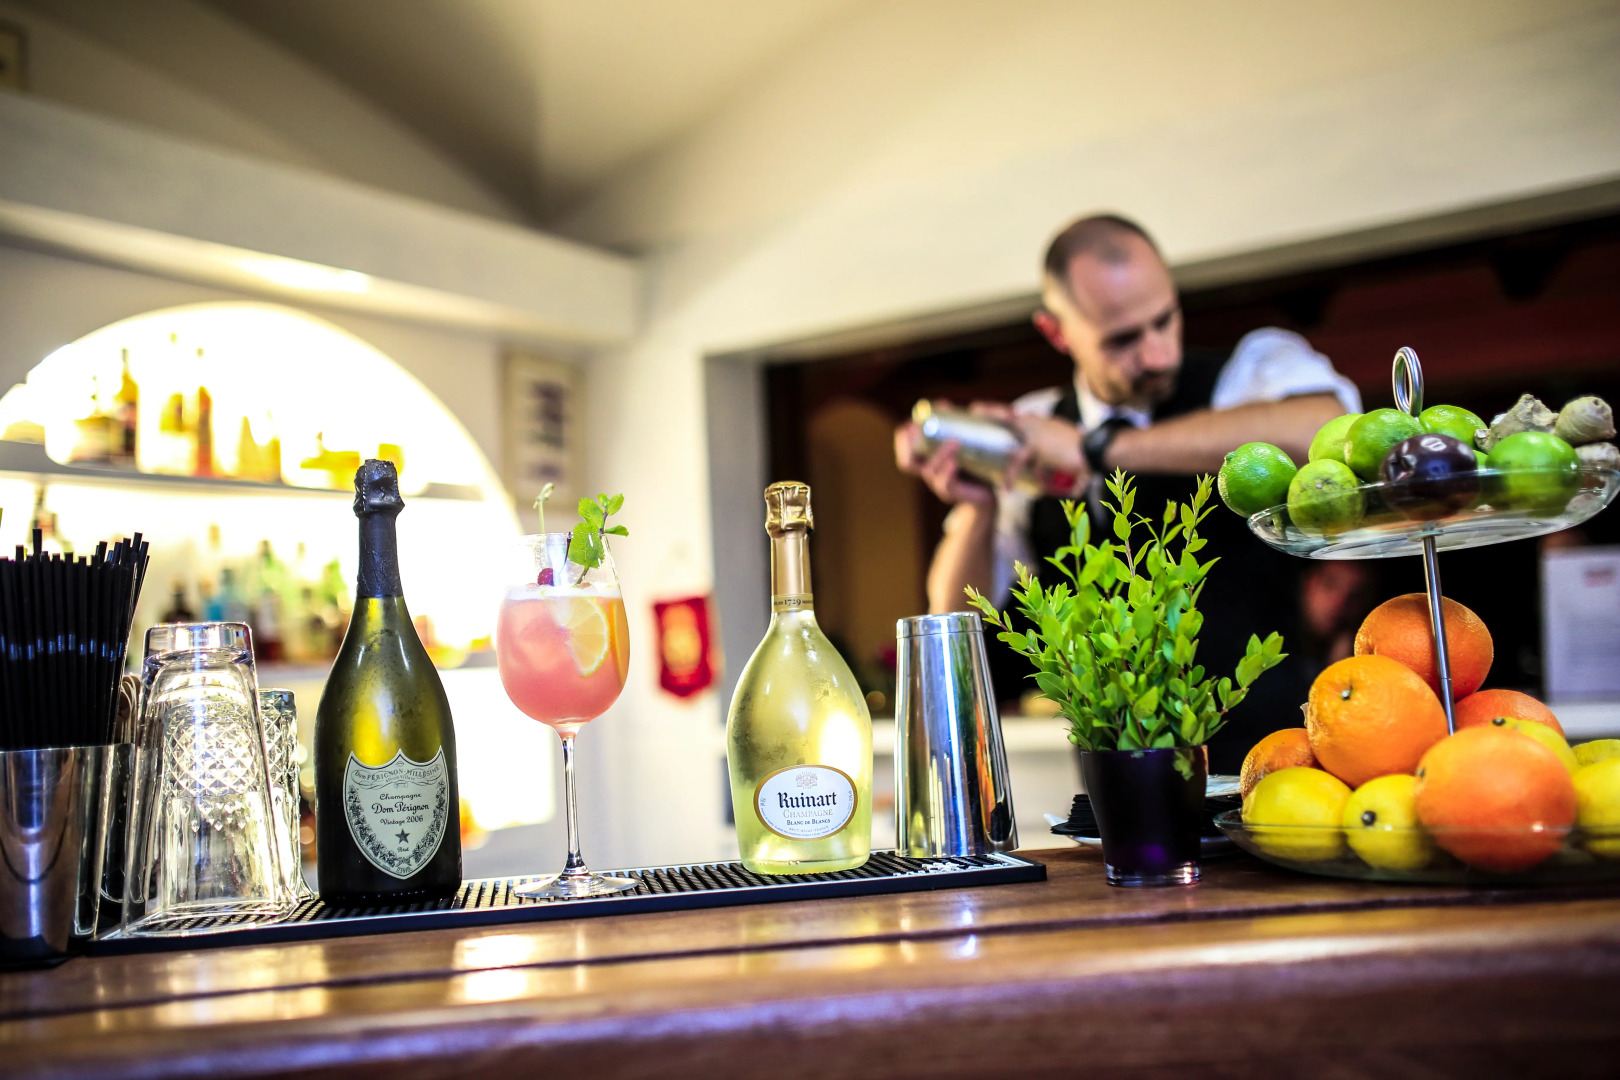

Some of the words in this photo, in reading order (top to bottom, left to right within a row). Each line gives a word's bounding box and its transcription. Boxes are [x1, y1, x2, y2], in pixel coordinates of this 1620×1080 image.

[778, 792, 836, 808] Ruinart
[372, 802, 394, 814] Dom
[394, 802, 430, 814] Pérignon
